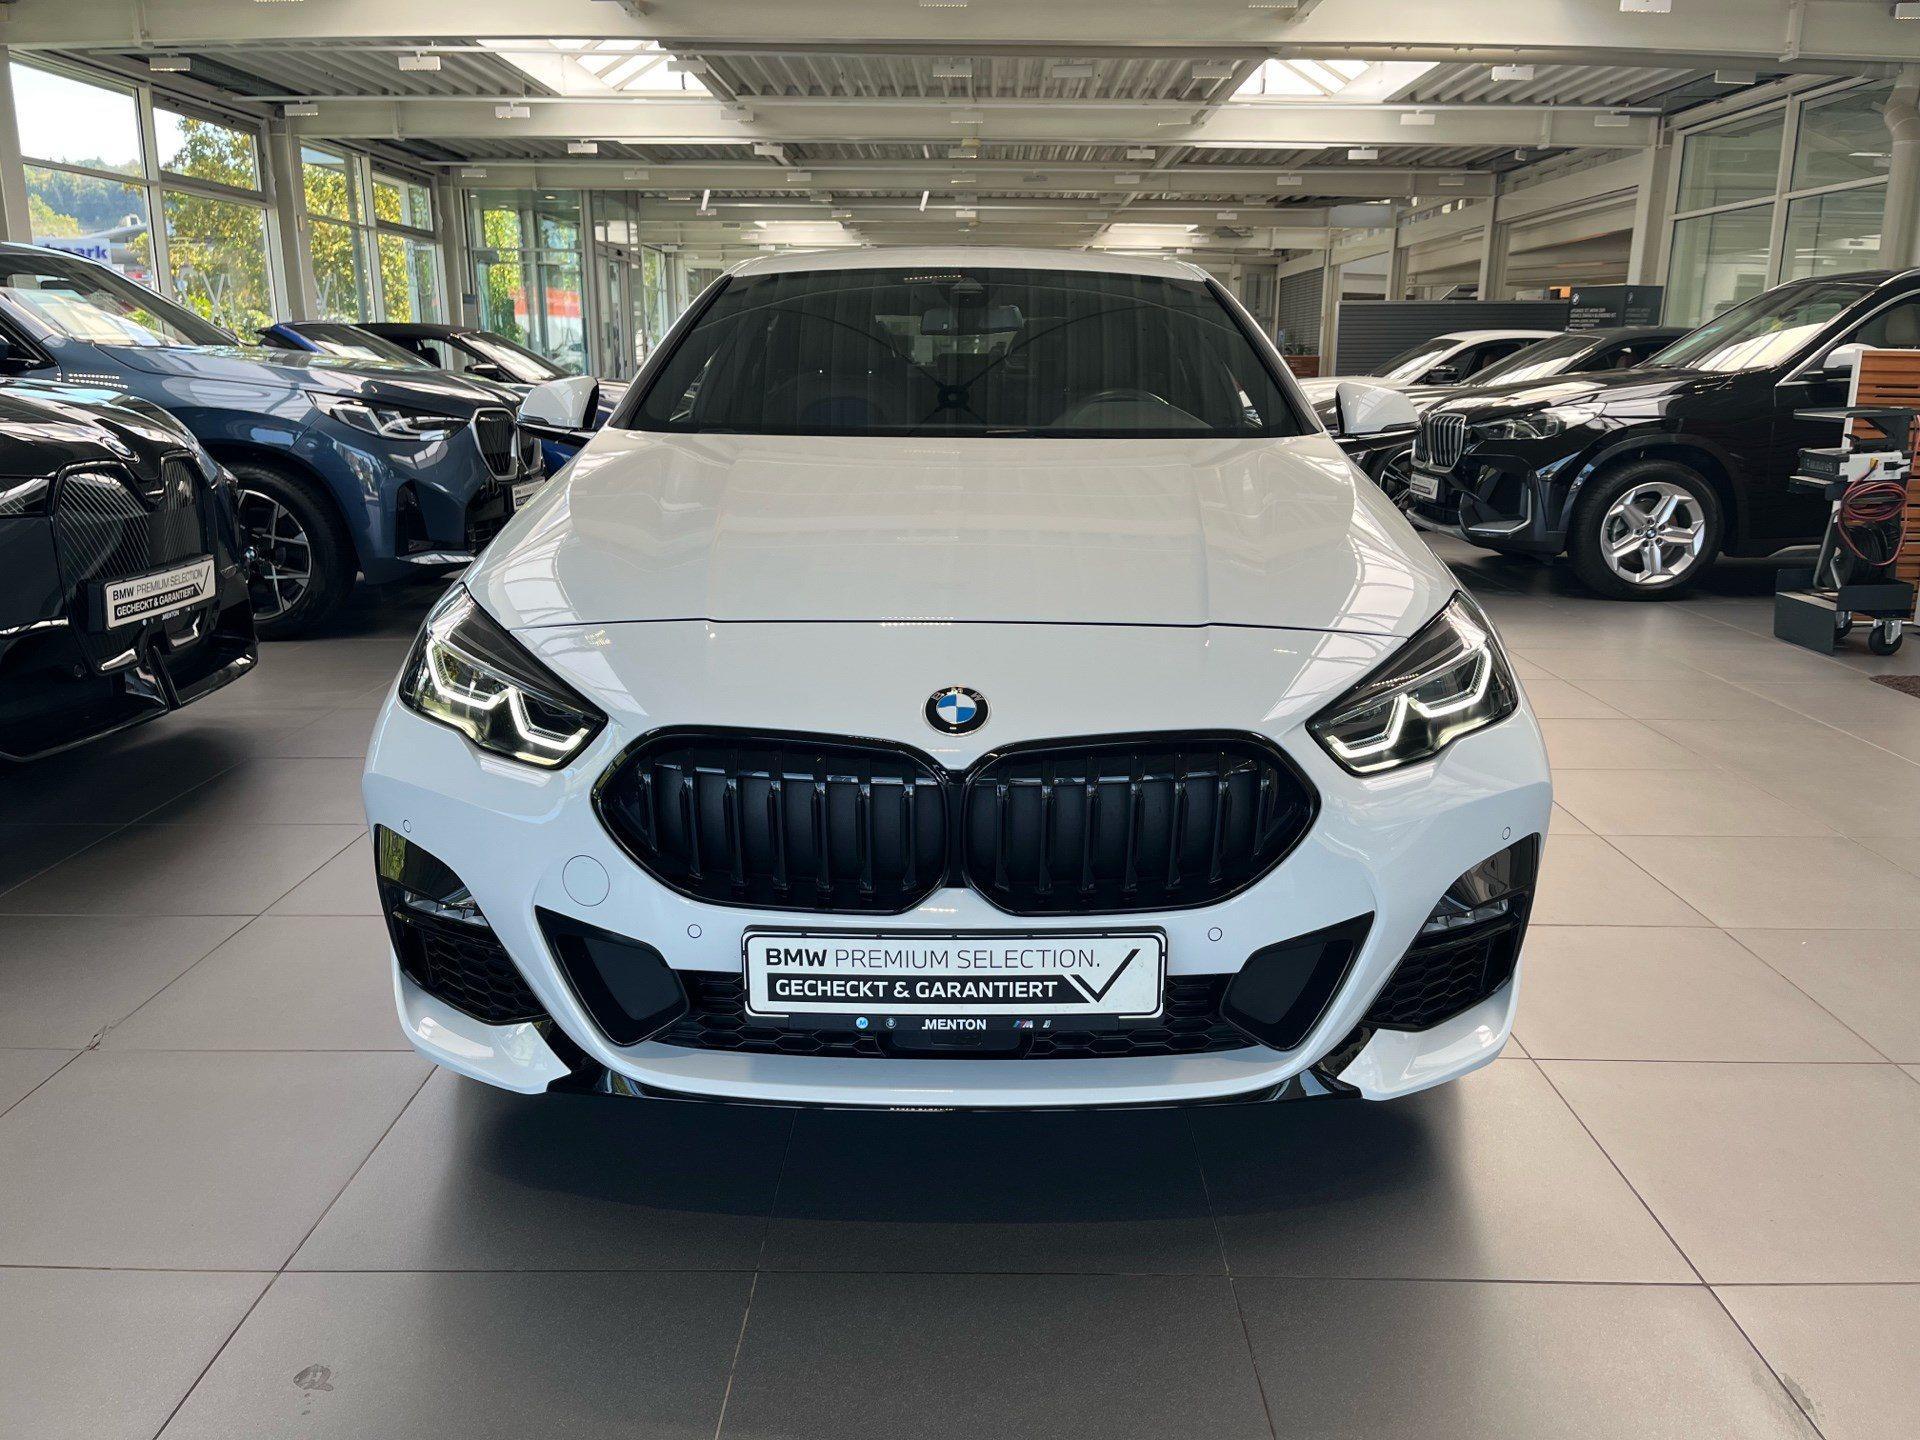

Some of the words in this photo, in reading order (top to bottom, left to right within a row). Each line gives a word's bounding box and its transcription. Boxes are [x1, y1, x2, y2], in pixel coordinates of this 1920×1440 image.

[113, 587, 135, 601] BMW
[136, 579, 170, 596] PREMIUM
[116, 599, 154, 617] GECHECKT
[153, 597, 159, 607] &
[159, 587, 195, 605] GARANTIERT
[765, 948, 828, 967] BMW
[835, 949, 949, 969] PREMIUM
[957, 949, 1101, 969] SELECTION.
[775, 979, 889, 998] GECHECKT
[893, 981, 911, 998] &
[915, 981, 1059, 998] GARANTIERT
[922, 1018, 988, 1031] MENTON
